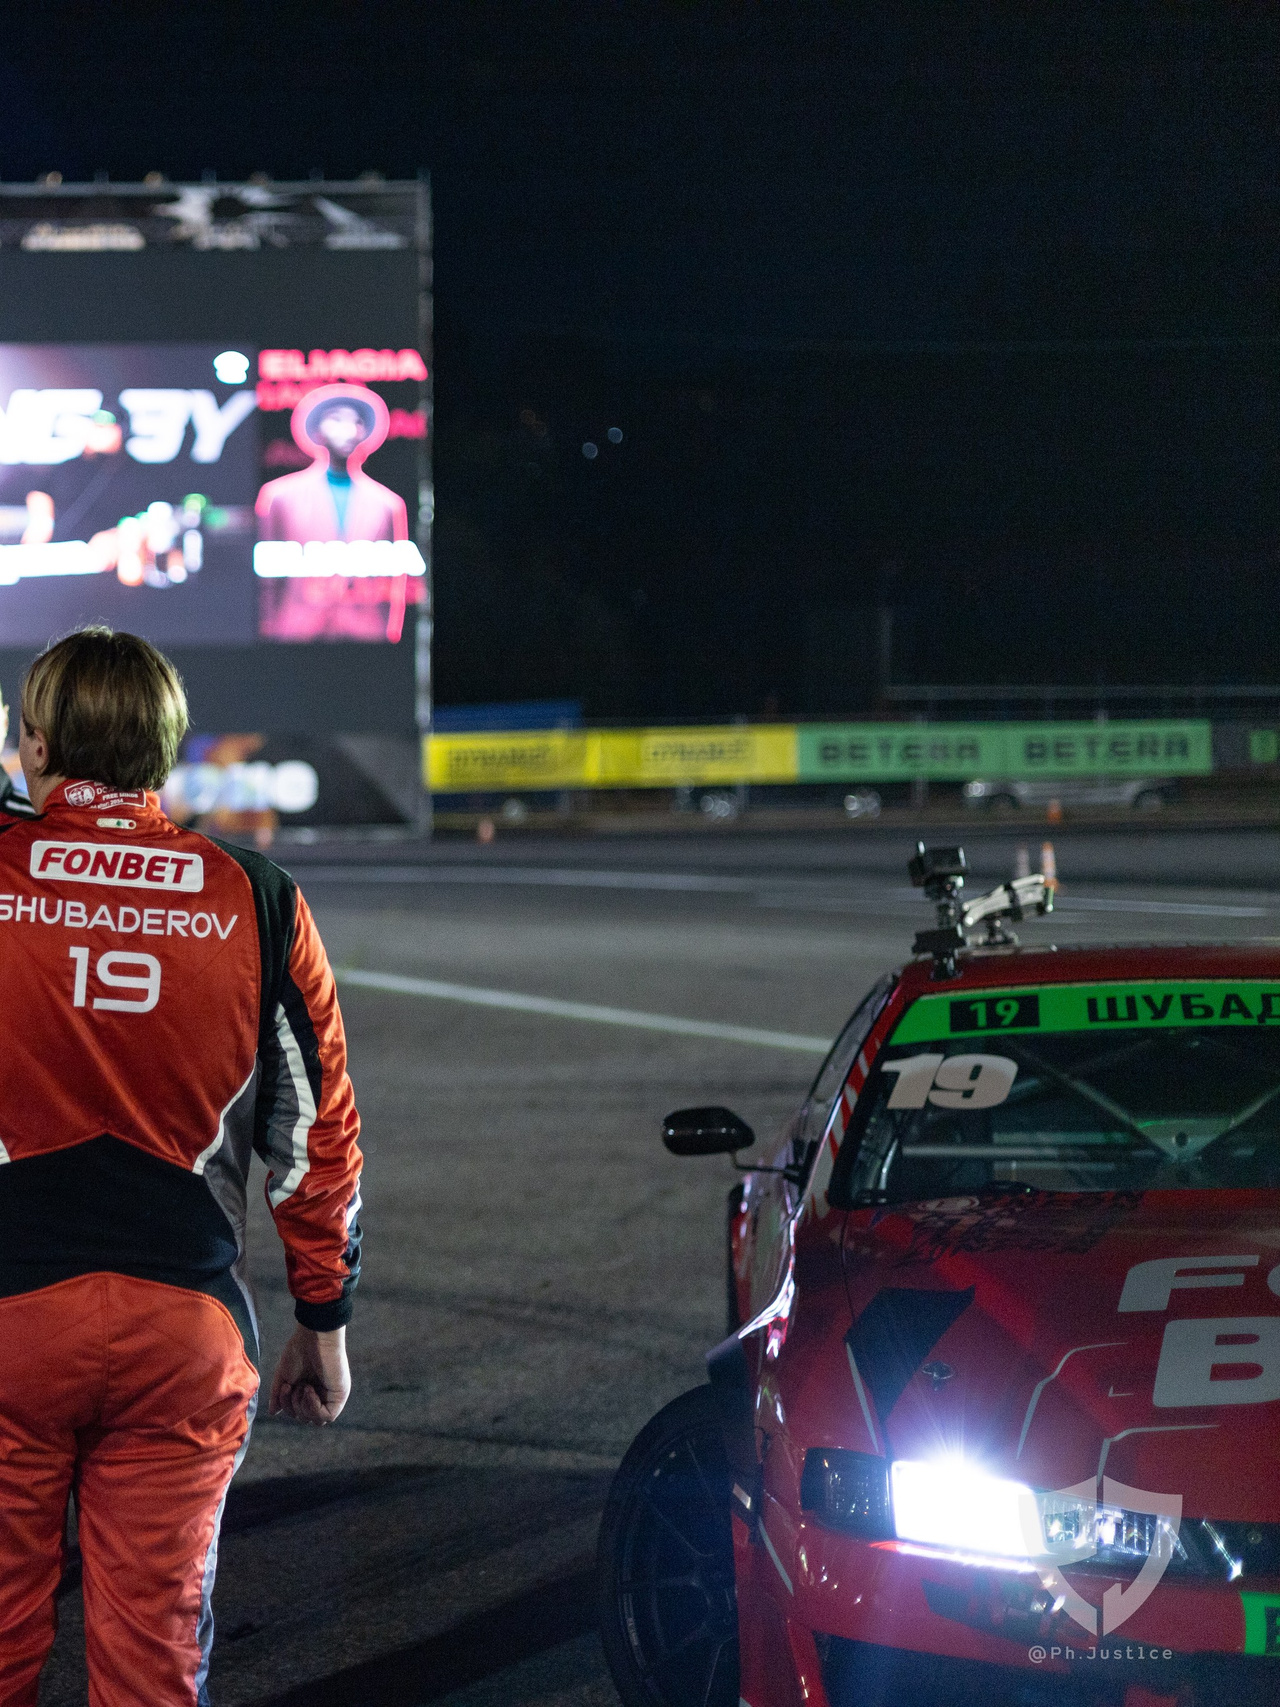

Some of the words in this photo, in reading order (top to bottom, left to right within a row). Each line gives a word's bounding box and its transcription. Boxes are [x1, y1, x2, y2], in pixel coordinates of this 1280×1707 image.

[38, 847, 194, 884] FONBET
[68, 946, 162, 1014] 19
[970, 1000, 1021, 1027] 19
[881, 1053, 1019, 1110] 19
